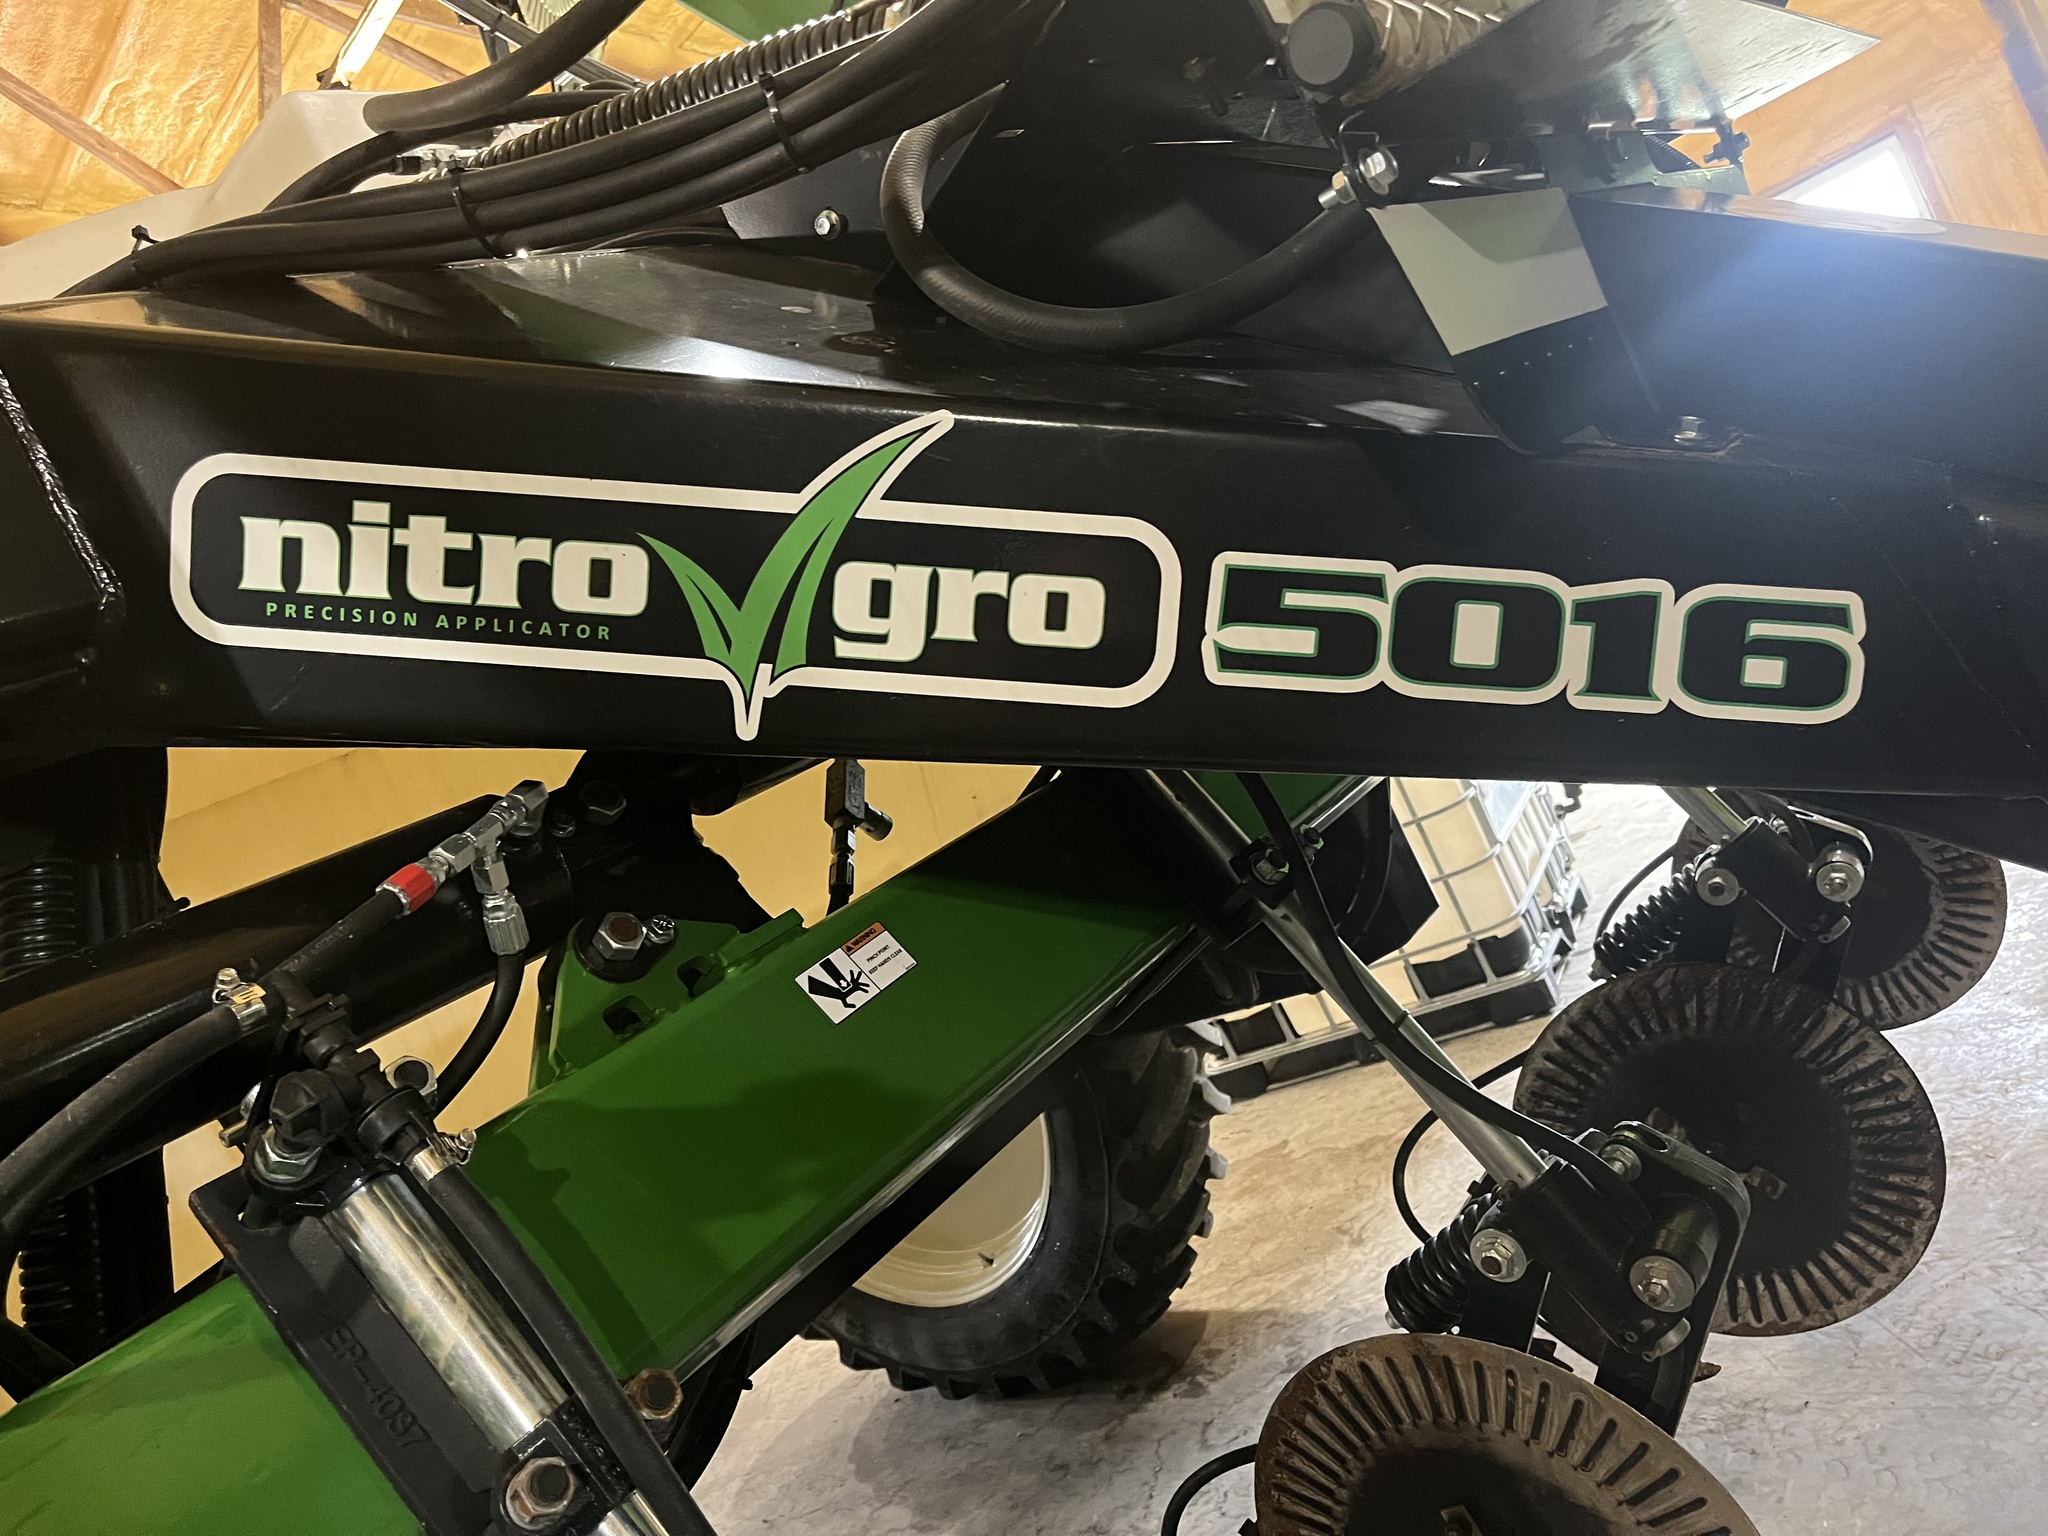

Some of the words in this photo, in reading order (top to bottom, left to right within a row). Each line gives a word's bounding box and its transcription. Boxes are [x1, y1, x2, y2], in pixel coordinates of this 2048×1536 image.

[238, 500, 650, 616] nitro
[833, 561, 1106, 662] gro
[266, 602, 419, 628] PRECISION
[435, 613, 612, 641] APPLICATOR
[1207, 557, 1861, 718] 5016
[851, 928, 876, 946] WARNING
